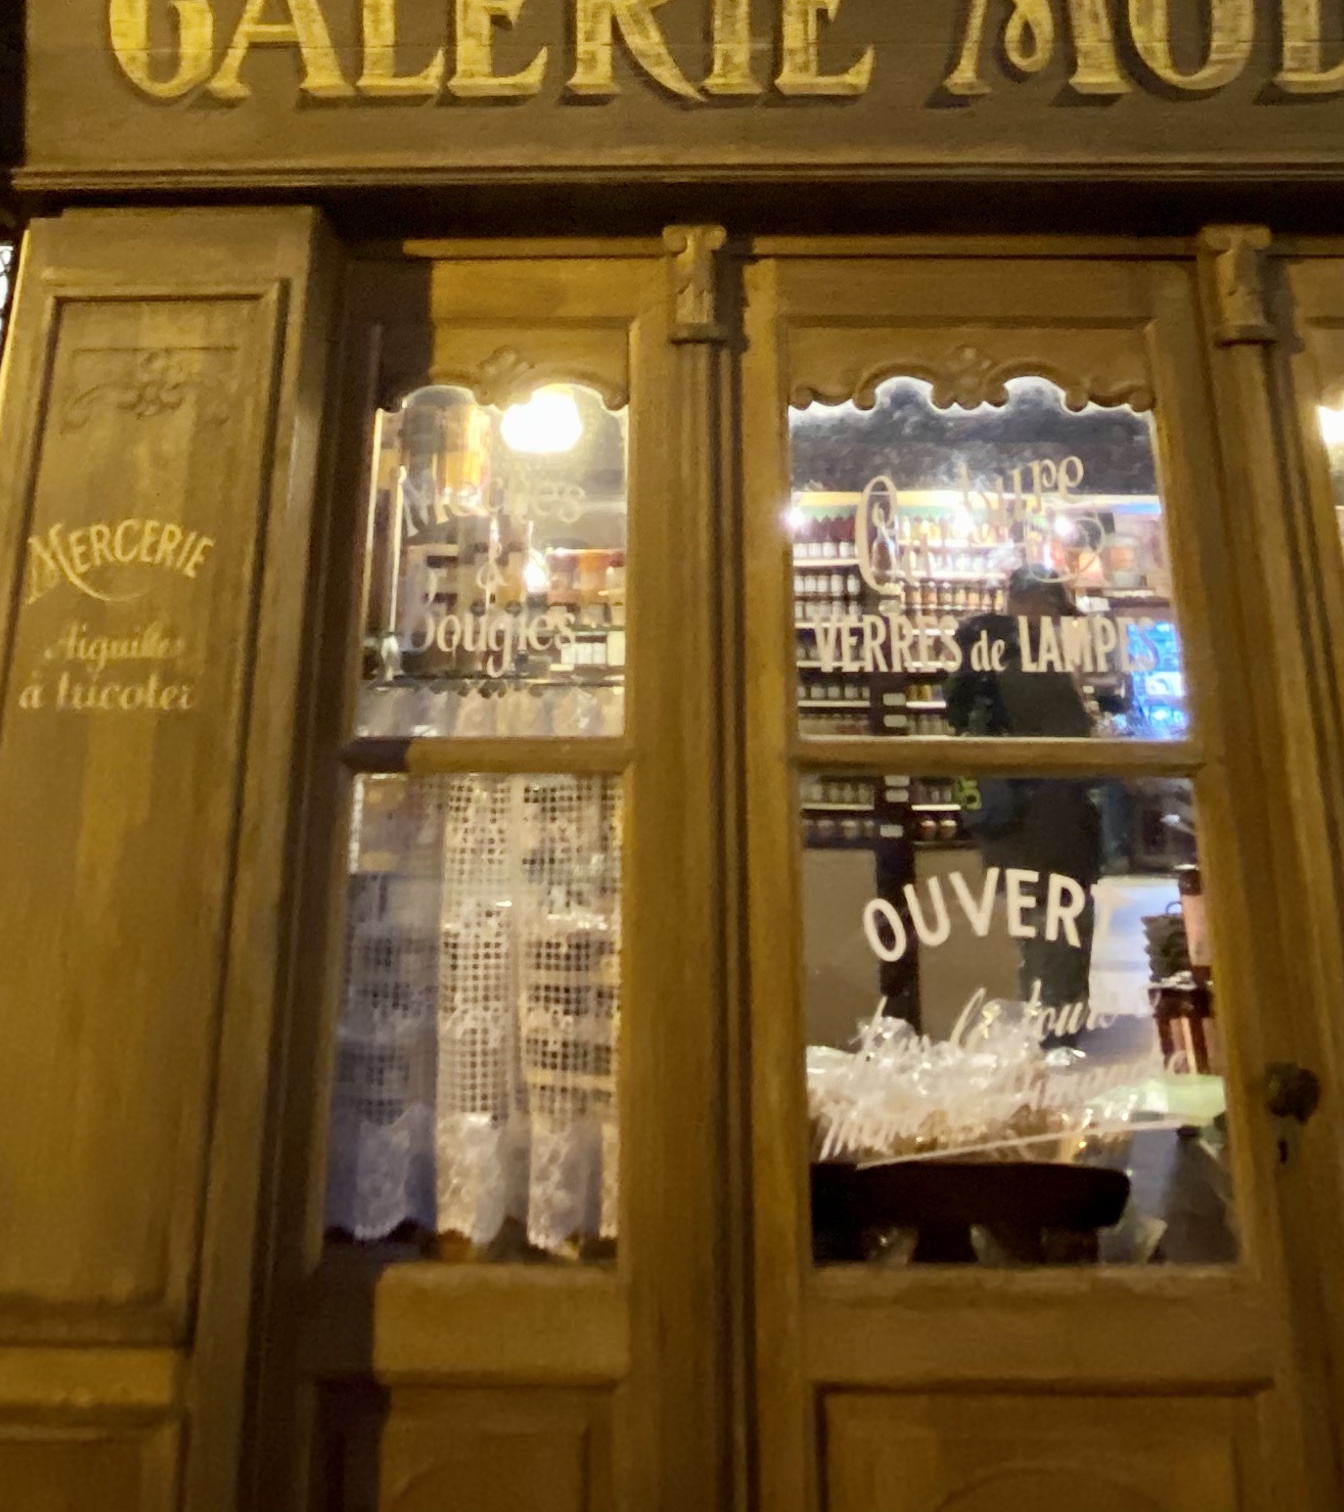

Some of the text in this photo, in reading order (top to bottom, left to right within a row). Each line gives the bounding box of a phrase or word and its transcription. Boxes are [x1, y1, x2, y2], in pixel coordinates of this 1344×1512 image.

[25, 518, 216, 605] MERCERIE
[813, 615, 1158, 673] VERRES de LAMPES
[862, 867, 1128, 962] OUVERT
